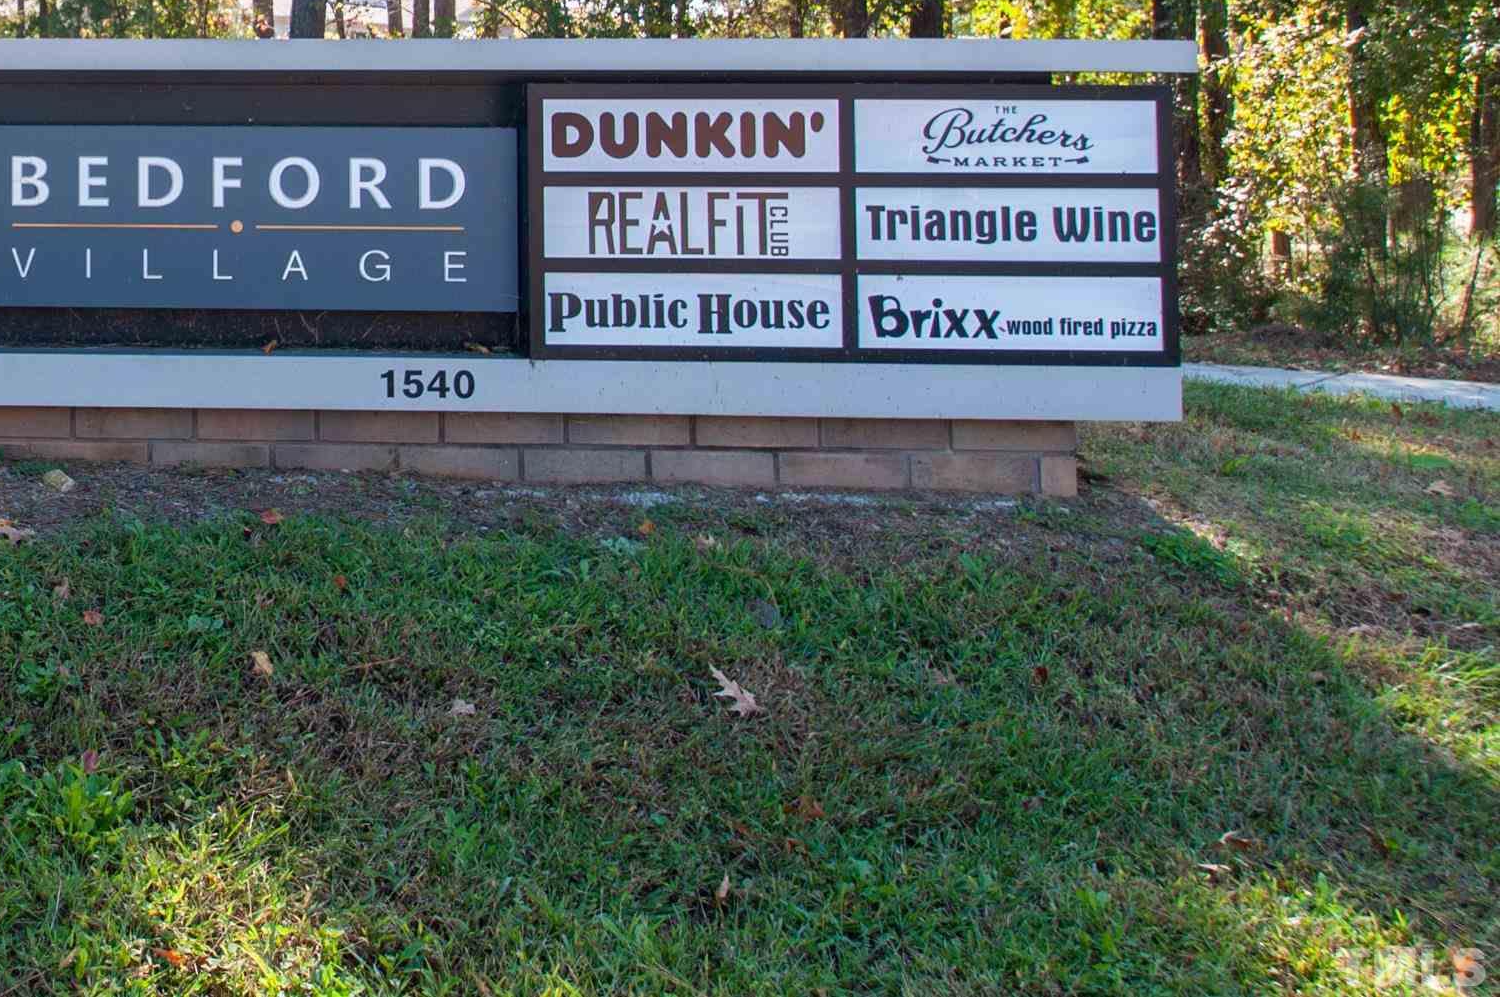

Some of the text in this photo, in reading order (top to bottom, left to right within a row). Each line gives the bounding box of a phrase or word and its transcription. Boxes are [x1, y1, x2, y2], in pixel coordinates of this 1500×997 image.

[921, 107, 1095, 154] Butchers
[994, 105, 1018, 115] THE
[550, 110, 825, 159] DUNKIN'
[10, 155, 467, 210] BEDFORD
[953, 156, 1062, 167] MARKET
[587, 191, 788, 256] REALFIT
[769, 206, 789, 257] CLUB
[865, 204, 1157, 246] Triangle Wine
[10, 246, 468, 283] VILLAGE
[547, 291, 831, 335] Public House
[867, 294, 1158, 339] Brixx wood fired pizza
[378, 368, 477, 401] 1540
